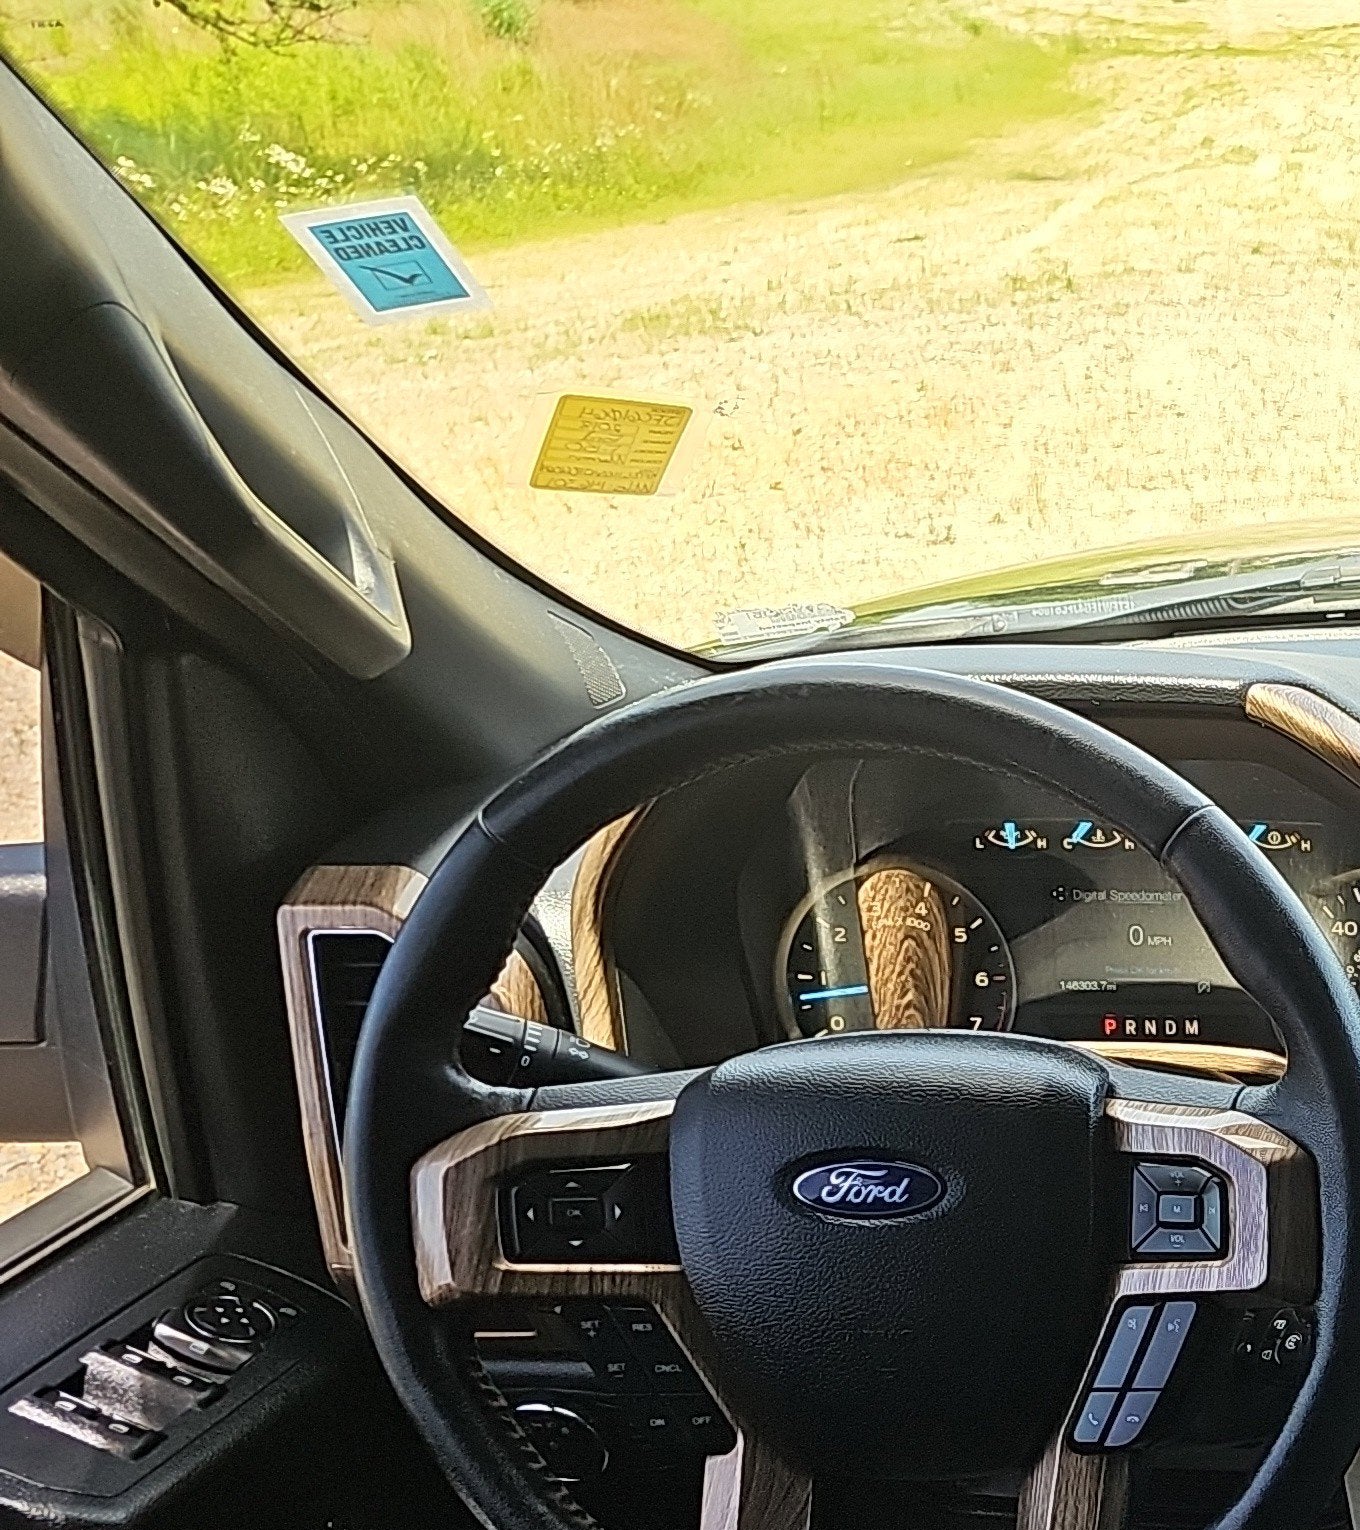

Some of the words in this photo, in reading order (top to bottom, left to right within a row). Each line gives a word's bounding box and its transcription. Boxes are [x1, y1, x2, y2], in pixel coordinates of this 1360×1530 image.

[1037, 837, 1047, 849] H
[1072, 889, 1107, 903] Digital
[1110, 889, 1183, 903] Speedometer
[914, 901, 928, 917] 4
[834, 927, 847, 942] 2
[954, 927, 968, 943] 5
[1129, 925, 1144, 946] 0
[1147, 935, 1172, 946] MPH
[1331, 921, 1358, 936] 40
[975, 971, 989, 987] 6
[830, 1016, 844, 1031] 0
[969, 1017, 983, 1031] 7
[1104, 1018, 1117, 1035] P
[1125, 1019, 1137, 1035] R
[1145, 1019, 1157, 1036] N
[1165, 1019, 1177, 1035] D
[1185, 1019, 1199, 1035] M
[821, 1167, 911, 1204] Ford
[1170, 1233, 1186, 1244] VOL
[691, 1416, 711, 1425] OFF
